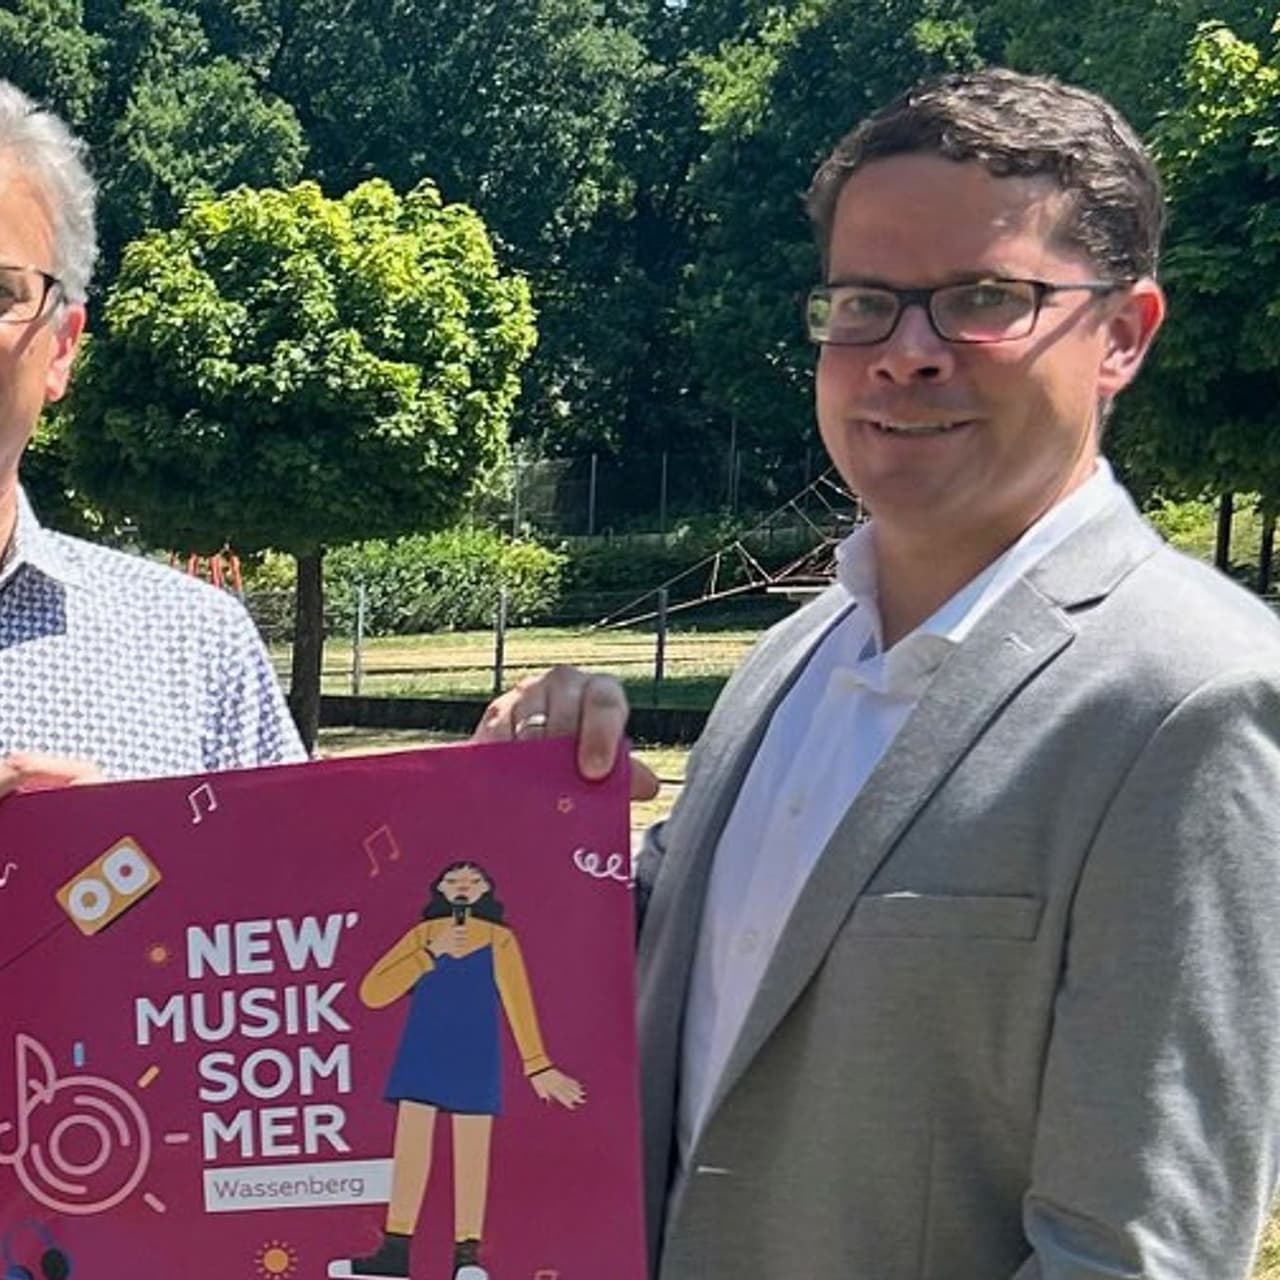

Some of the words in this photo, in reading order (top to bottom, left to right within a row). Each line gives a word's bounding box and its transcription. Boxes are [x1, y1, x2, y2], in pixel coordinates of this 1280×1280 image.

[135, 982, 352, 1045] MUSIK
[198, 1044, 351, 1102] SOM
[202, 1104, 351, 1160] MER
[213, 1176, 364, 1199] Wassenberg
